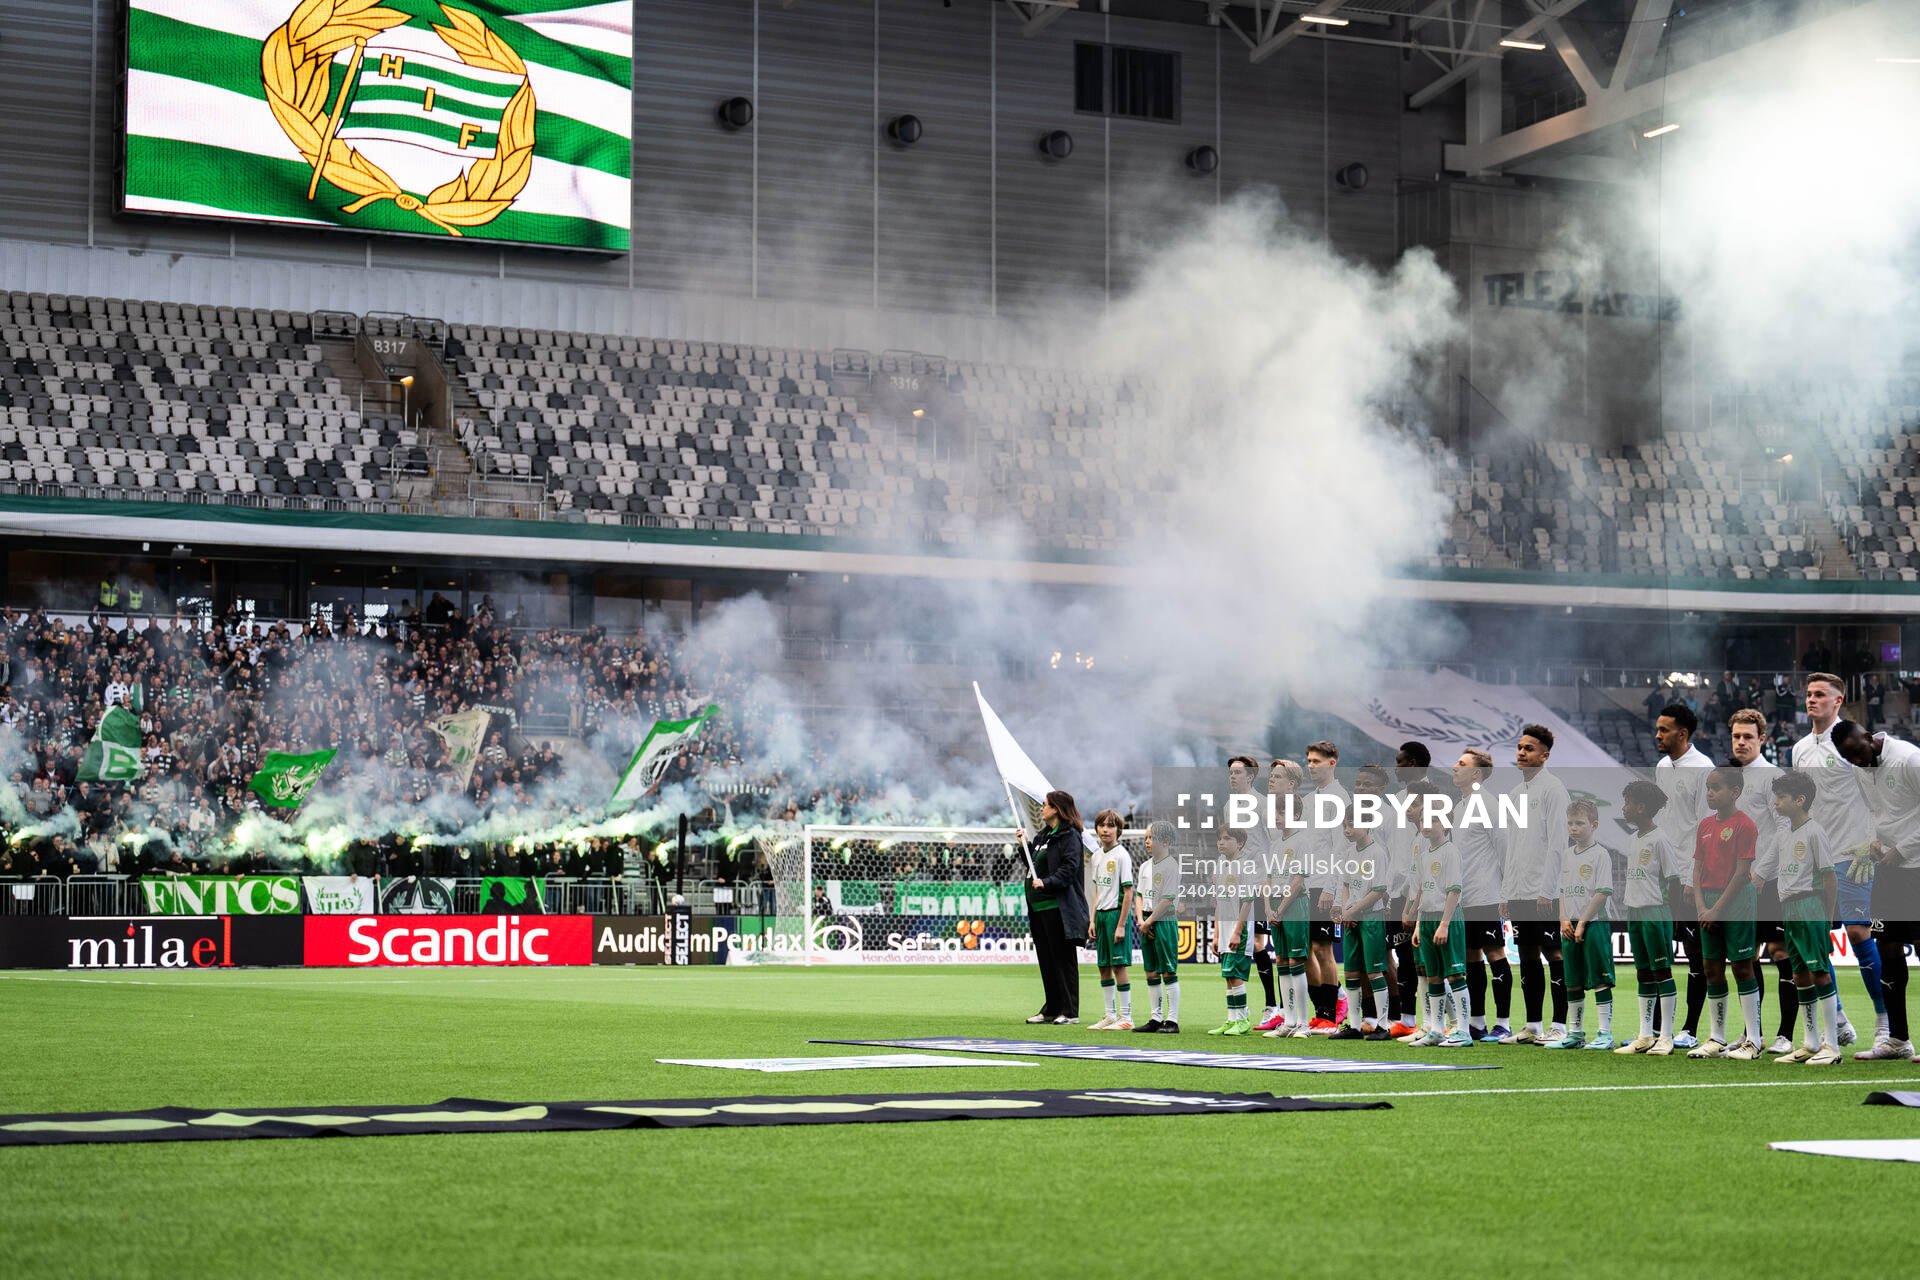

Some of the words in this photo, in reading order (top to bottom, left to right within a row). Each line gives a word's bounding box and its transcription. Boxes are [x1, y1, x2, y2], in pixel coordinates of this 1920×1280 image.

[374, 339, 406, 354] B317
[142, 877, 299, 915] FNTCS
[68, 916, 235, 967] milael
[348, 915, 549, 963] Scandic
[664, 913, 672, 965] SELECT
[675, 912, 689, 965] SELECT
[862, 953, 900, 962] Handla
